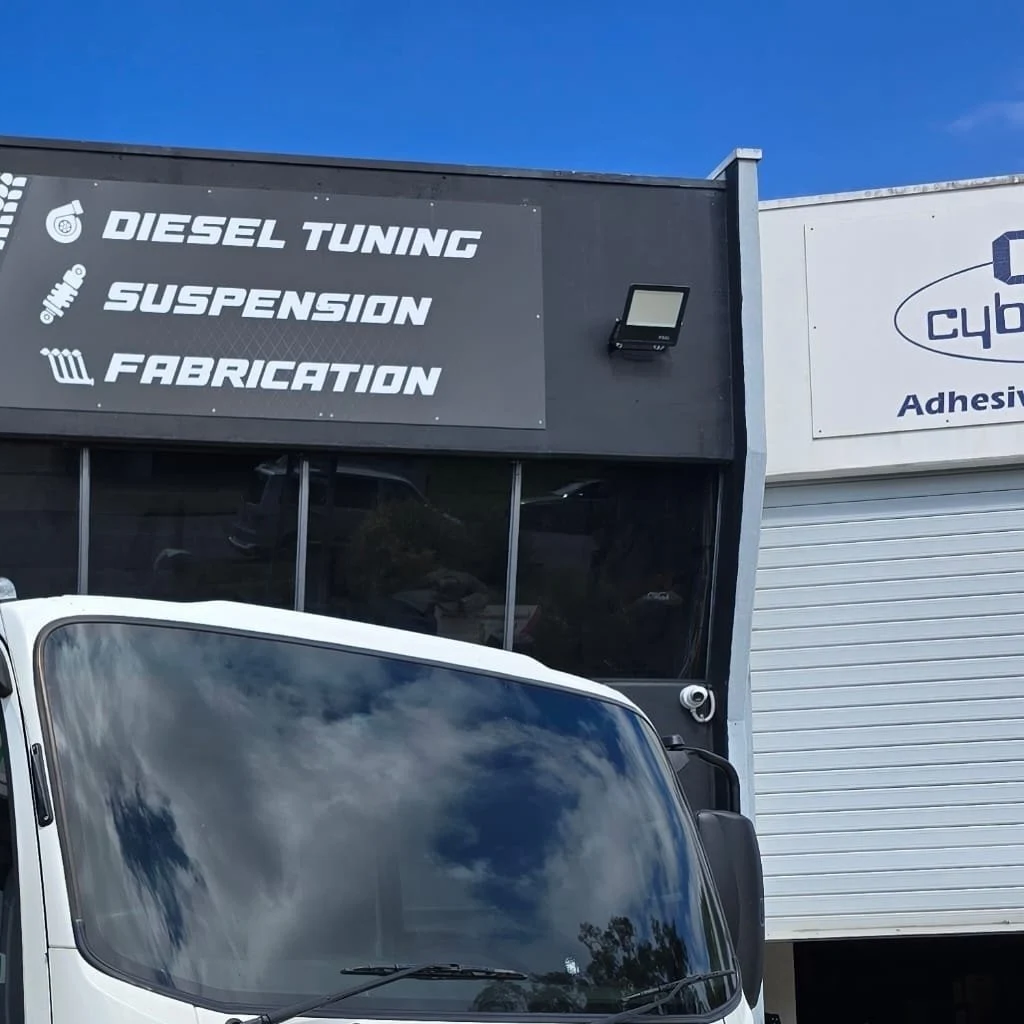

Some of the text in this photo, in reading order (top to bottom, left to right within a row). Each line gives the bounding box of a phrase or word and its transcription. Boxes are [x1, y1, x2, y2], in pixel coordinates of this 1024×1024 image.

[102, 210, 482, 259] DIESEL TUNING
[103, 281, 432, 326] SUSPENSION
[927, 292, 1024, 349] cyb
[103, 352, 442, 396] FABRICATION
